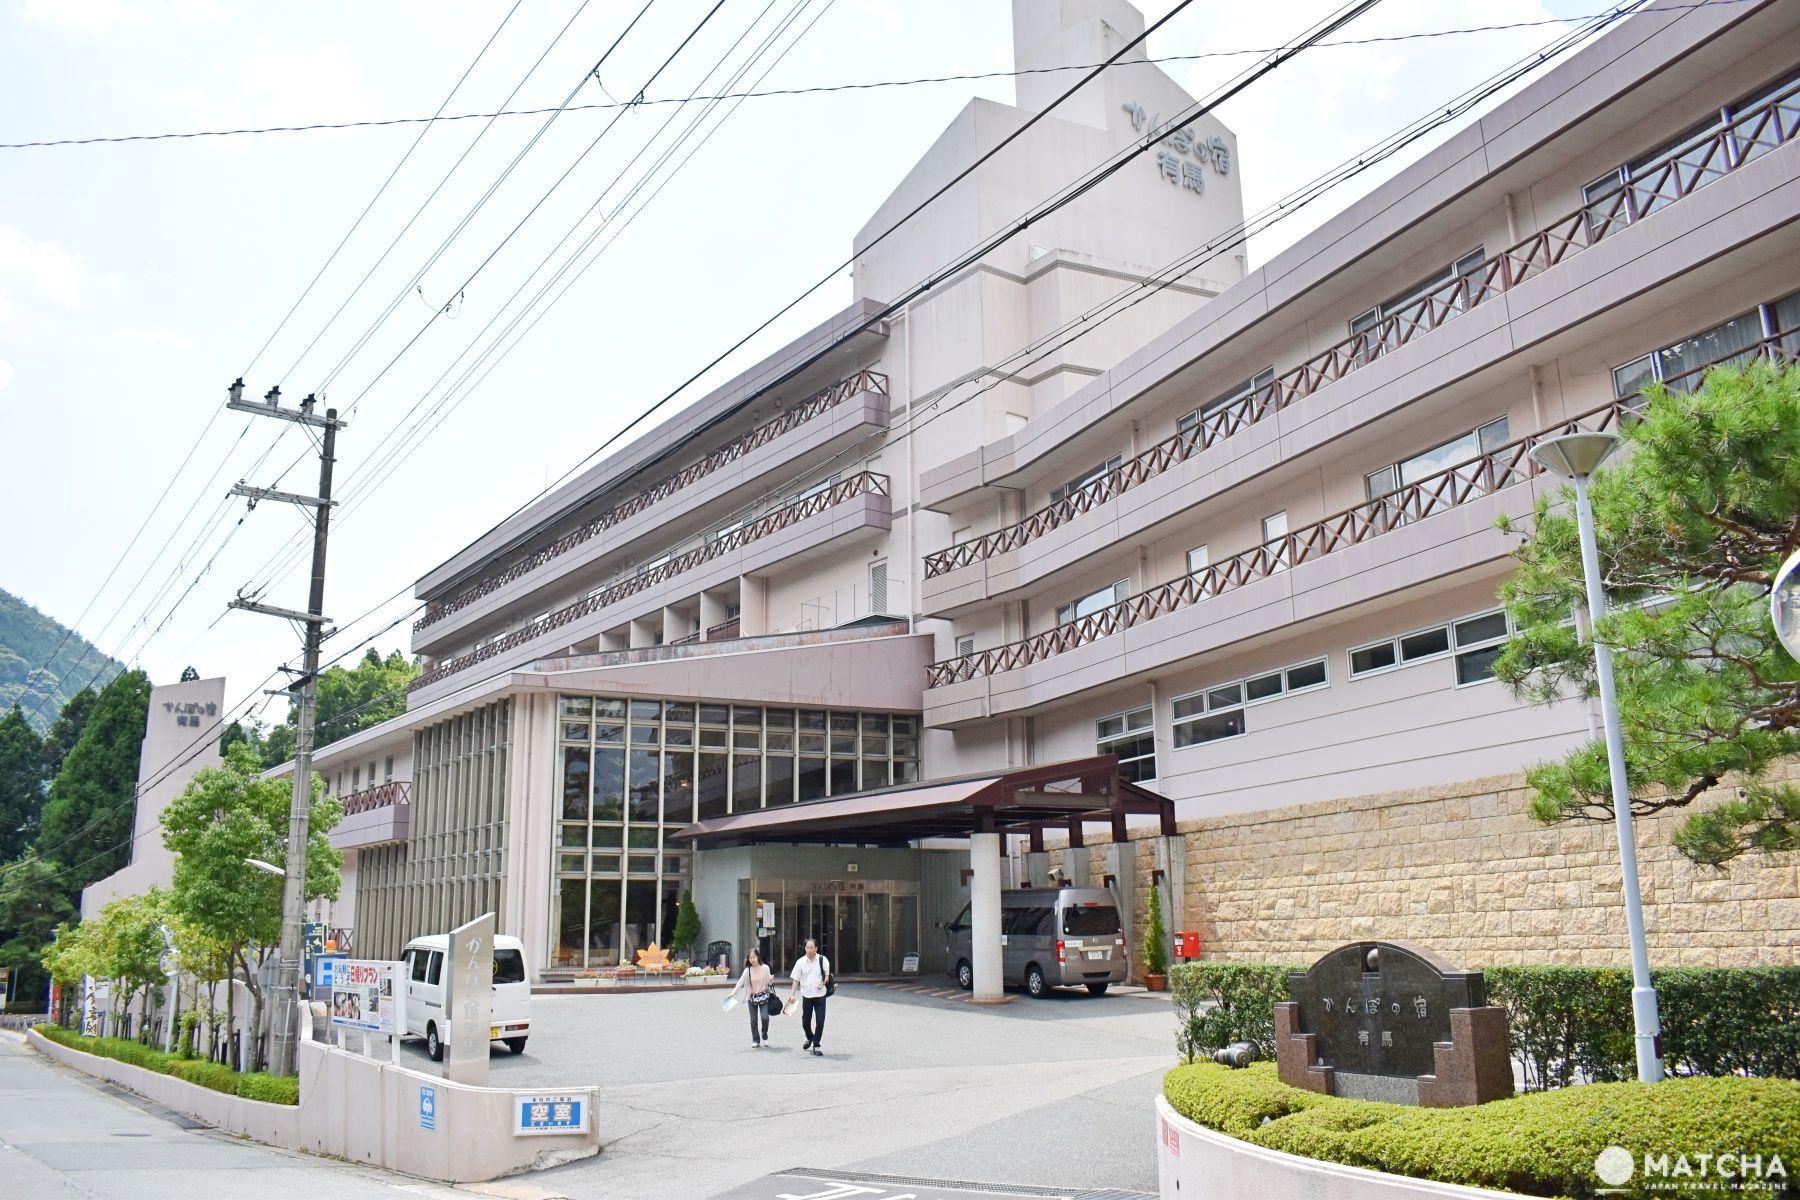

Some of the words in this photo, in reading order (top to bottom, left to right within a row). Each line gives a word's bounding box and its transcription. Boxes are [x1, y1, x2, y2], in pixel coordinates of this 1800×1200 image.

[1156, 150, 1206, 195] 有馬
[1323, 995, 1427, 1019] かんぽの宿
[1358, 1030, 1392, 1047] 有馬
[531, 1103, 571, 1121] 空室
